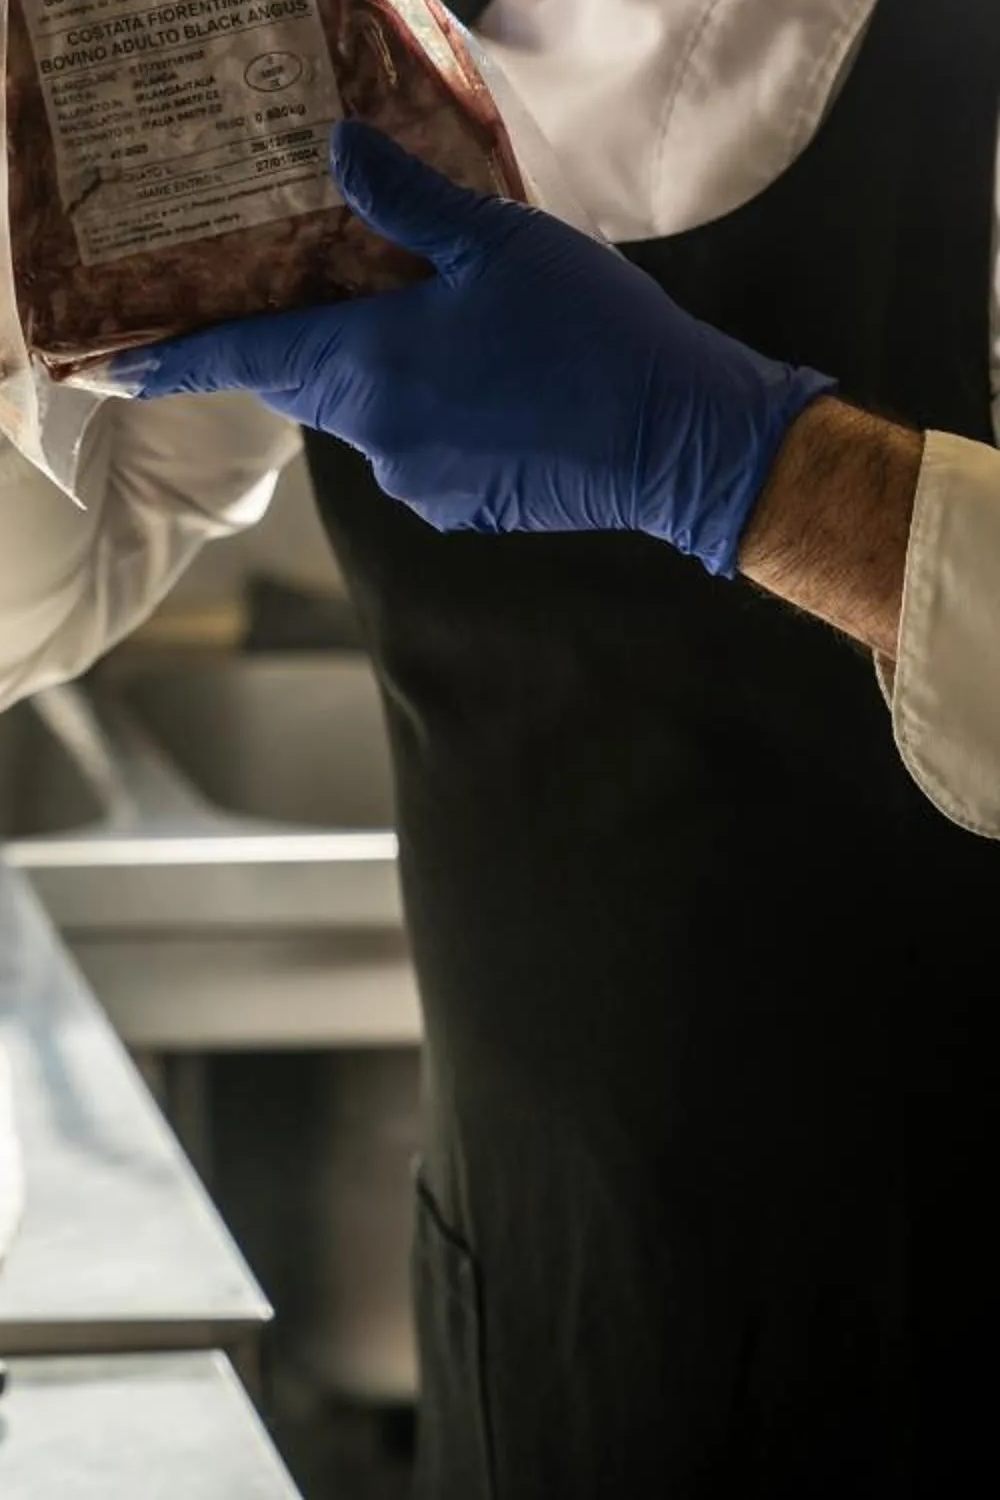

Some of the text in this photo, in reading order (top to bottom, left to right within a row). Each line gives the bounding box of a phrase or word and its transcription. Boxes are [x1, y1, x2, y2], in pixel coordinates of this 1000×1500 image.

[40, 46, 107, 74] BOVINO
[112, 28, 180, 54] ADULTO
[184, 13, 243, 39] BLACK
[67, 16, 144, 46] COSTATA
